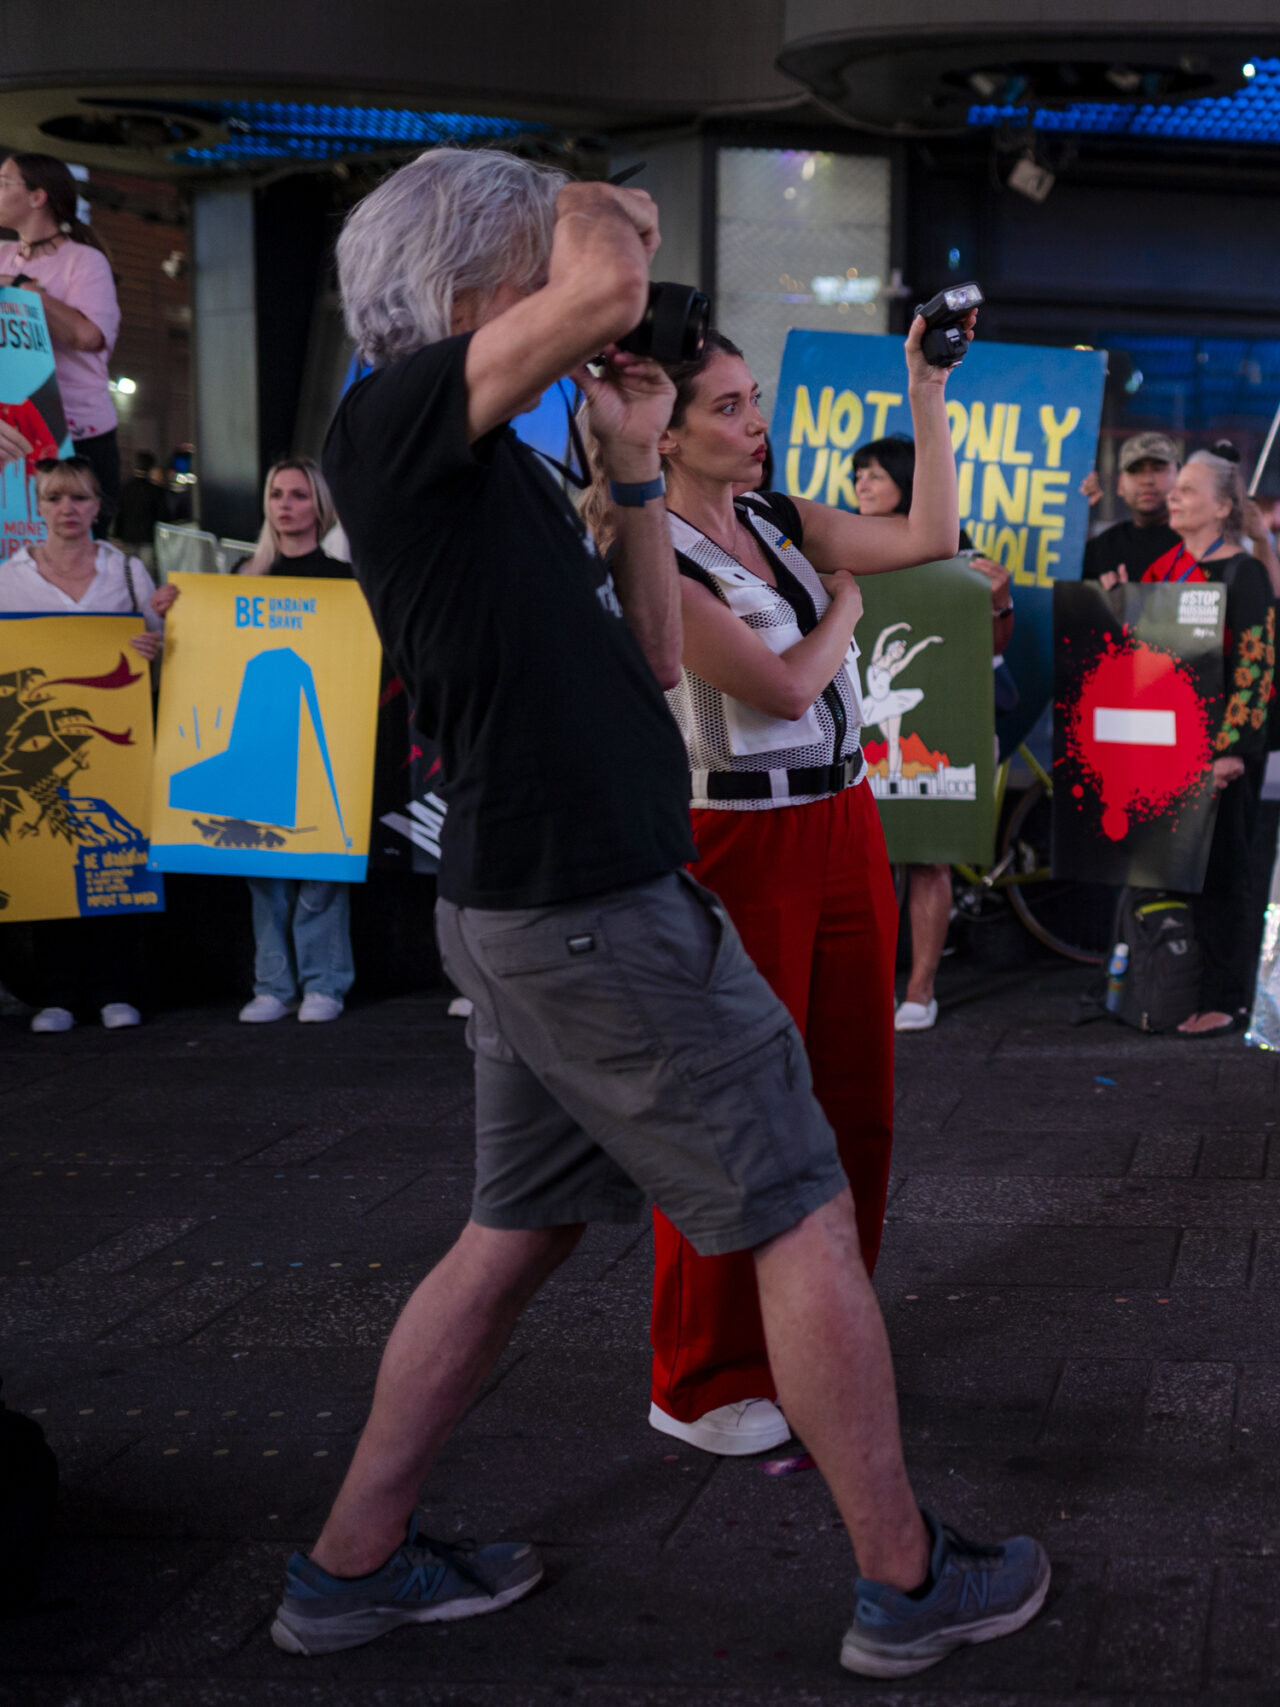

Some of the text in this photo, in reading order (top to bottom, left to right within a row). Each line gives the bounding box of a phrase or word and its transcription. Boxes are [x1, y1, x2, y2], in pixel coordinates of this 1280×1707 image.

[791, 385, 902, 449] NOT
[786, 447, 1070, 527] UKINE
[966, 520, 1063, 588] HOLE
[235, 595, 265, 628] BE
[1181, 590, 1220, 606] #STOP
